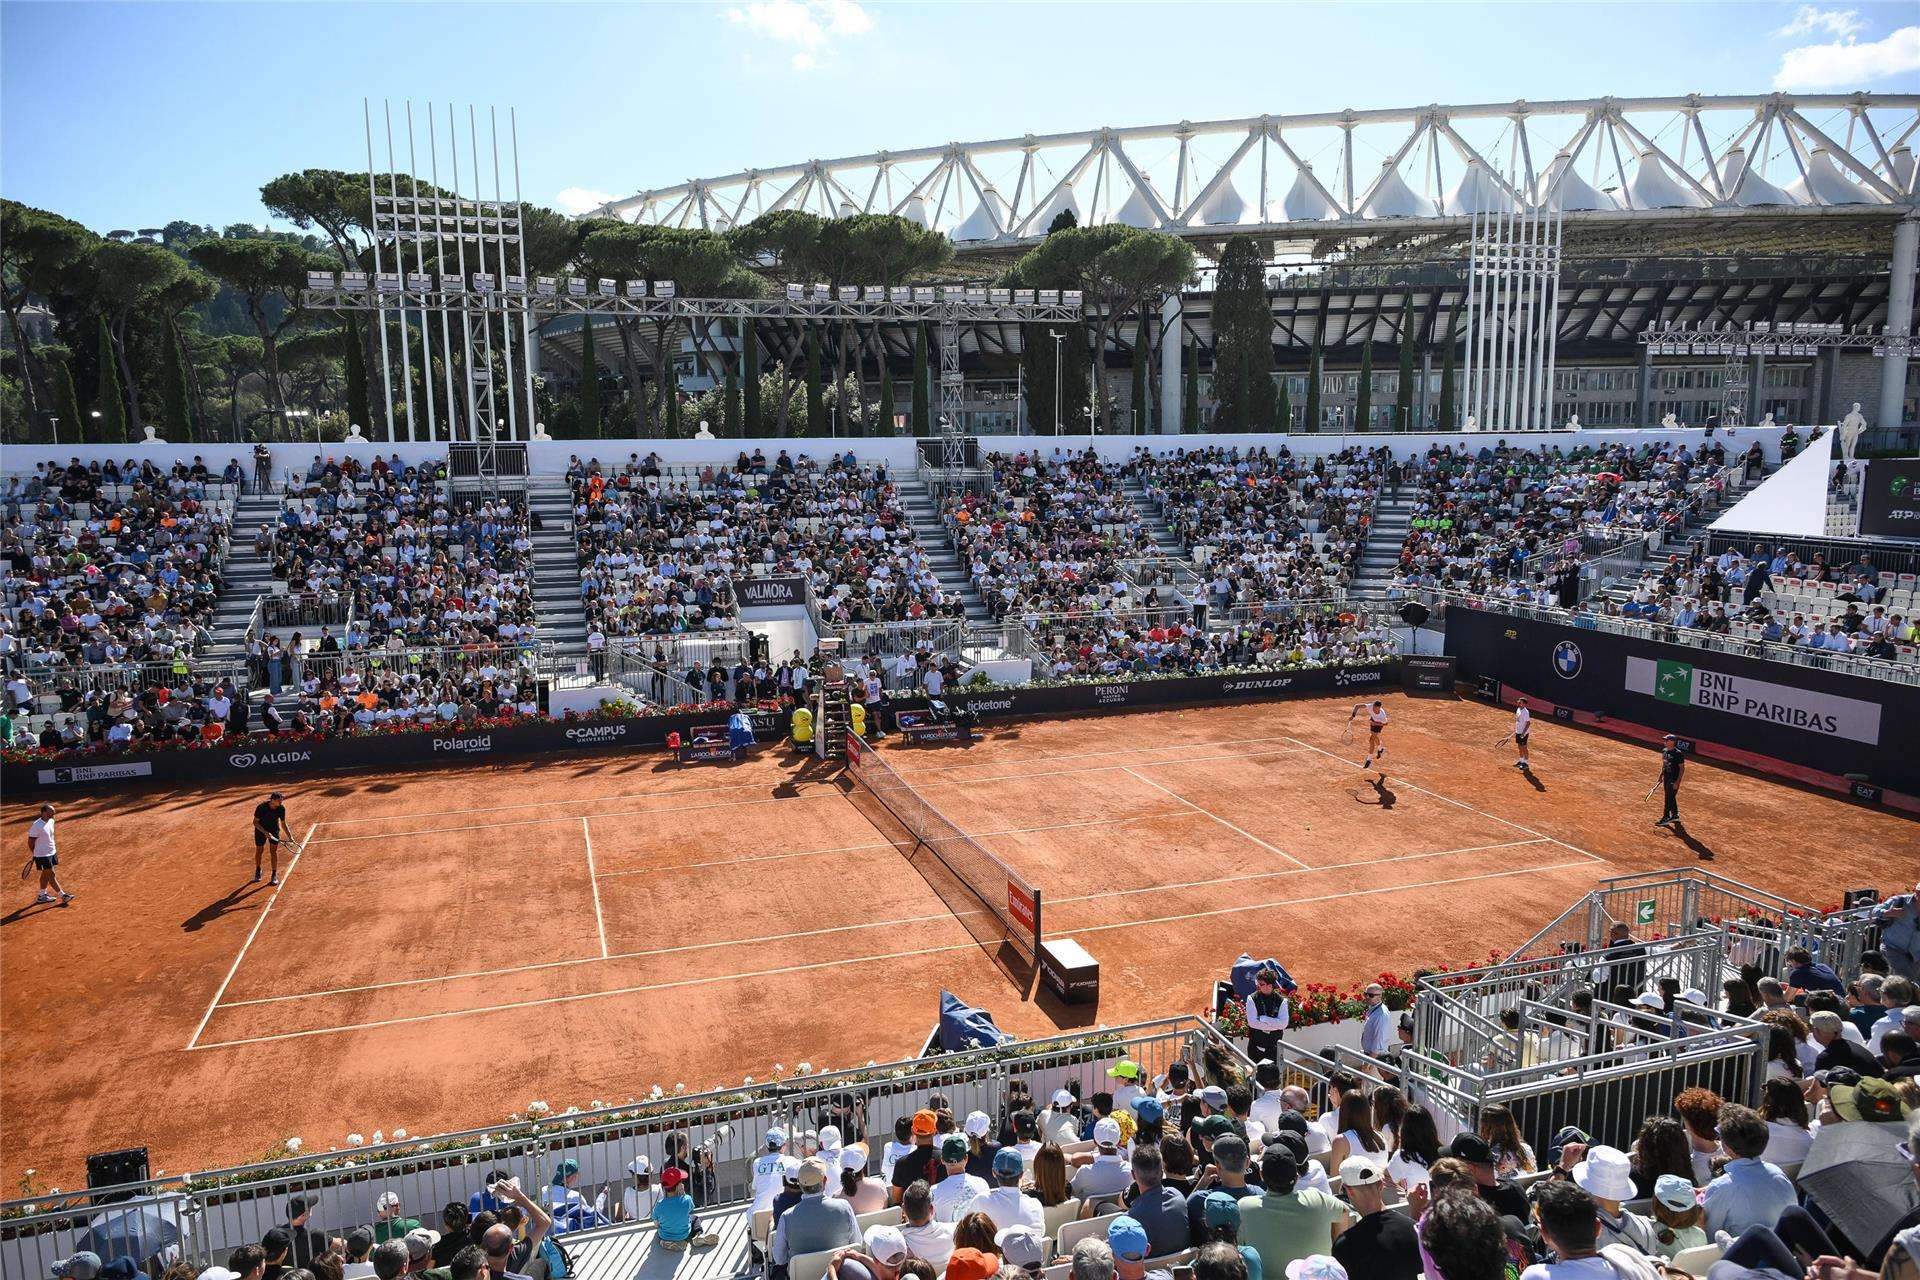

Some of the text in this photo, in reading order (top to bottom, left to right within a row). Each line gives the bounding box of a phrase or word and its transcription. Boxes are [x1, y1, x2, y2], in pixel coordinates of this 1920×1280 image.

[745, 583, 793, 599] VALMORA
[1234, 678, 1292, 690] DUNLOP
[1700, 672, 1738, 694] BNL
[1095, 685, 1129, 696] PERONI
[967, 700, 1011, 711] ticketone
[1698, 689, 1837, 733] BNP PARIBAS
[433, 735, 491, 751] Polaroid
[260, 751, 311, 764] ALGIDA
[98, 769, 137, 779] PARIBAS
[1857, 786, 1875, 799] EA7
[758, 1161, 785, 1174] GTA
